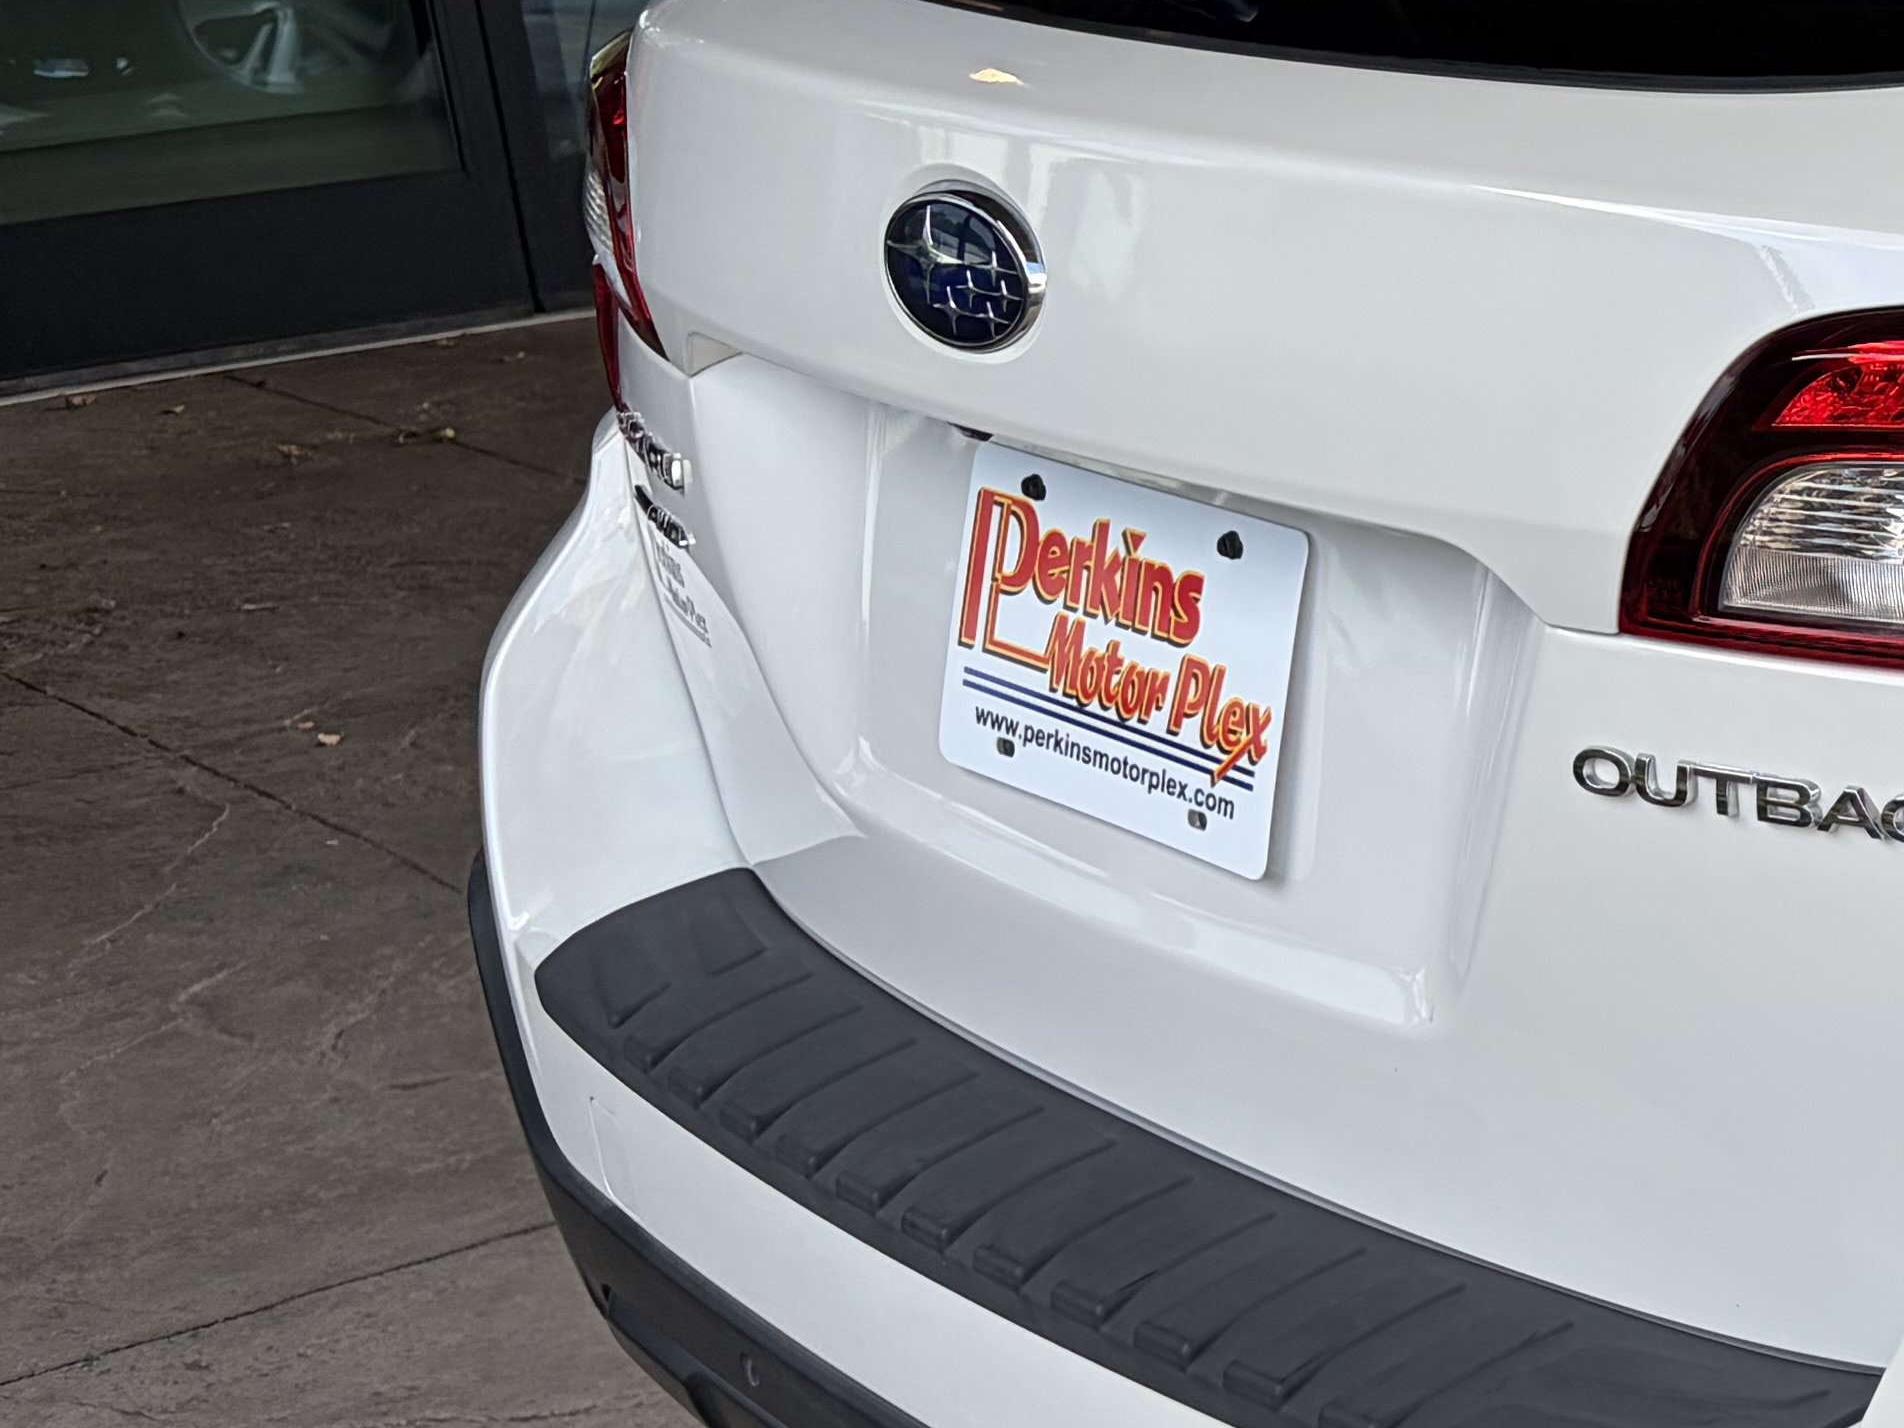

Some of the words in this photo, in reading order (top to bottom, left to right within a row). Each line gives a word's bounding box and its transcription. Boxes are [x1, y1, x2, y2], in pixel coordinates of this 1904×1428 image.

[958, 486, 1205, 652] Perkins
[974, 706, 1236, 821] www.perkinsmotorplex.com
[1046, 611, 1172, 724] Motor
[1168, 653, 1274, 786] Plex
